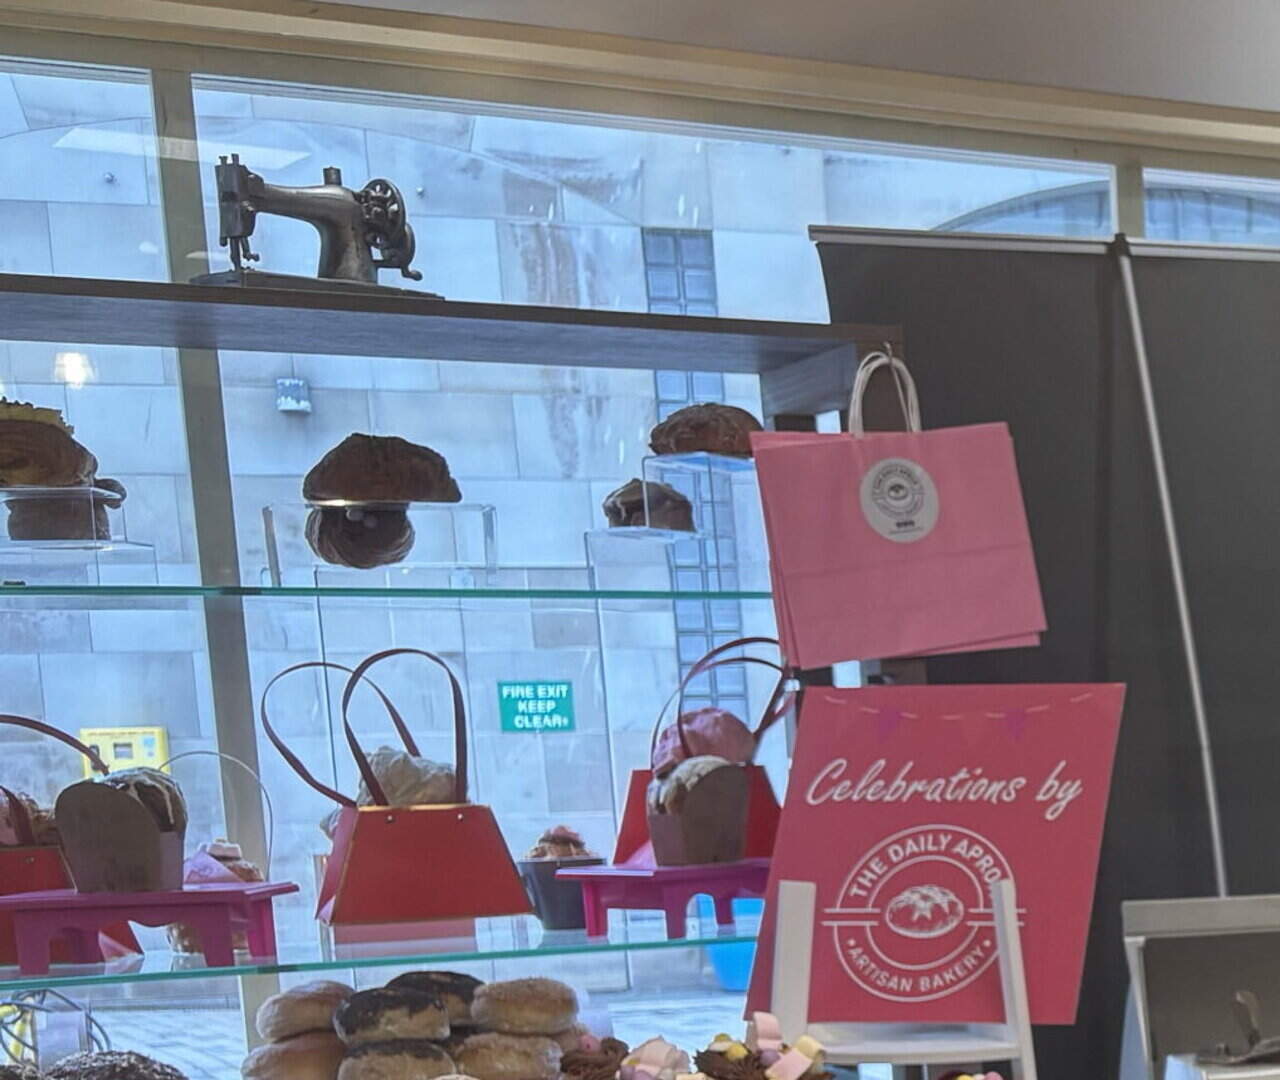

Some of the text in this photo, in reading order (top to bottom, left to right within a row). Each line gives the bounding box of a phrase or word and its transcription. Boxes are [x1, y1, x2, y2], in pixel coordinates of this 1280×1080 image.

[502, 684, 569, 699] FIRE EXIT
[517, 699, 557, 714] KEEP
[806, 757, 1084, 821] Celebrations by
[849, 833, 1004, 900] THE DAILY APRO
[848, 945, 986, 993] ARTISAN BAKERY
